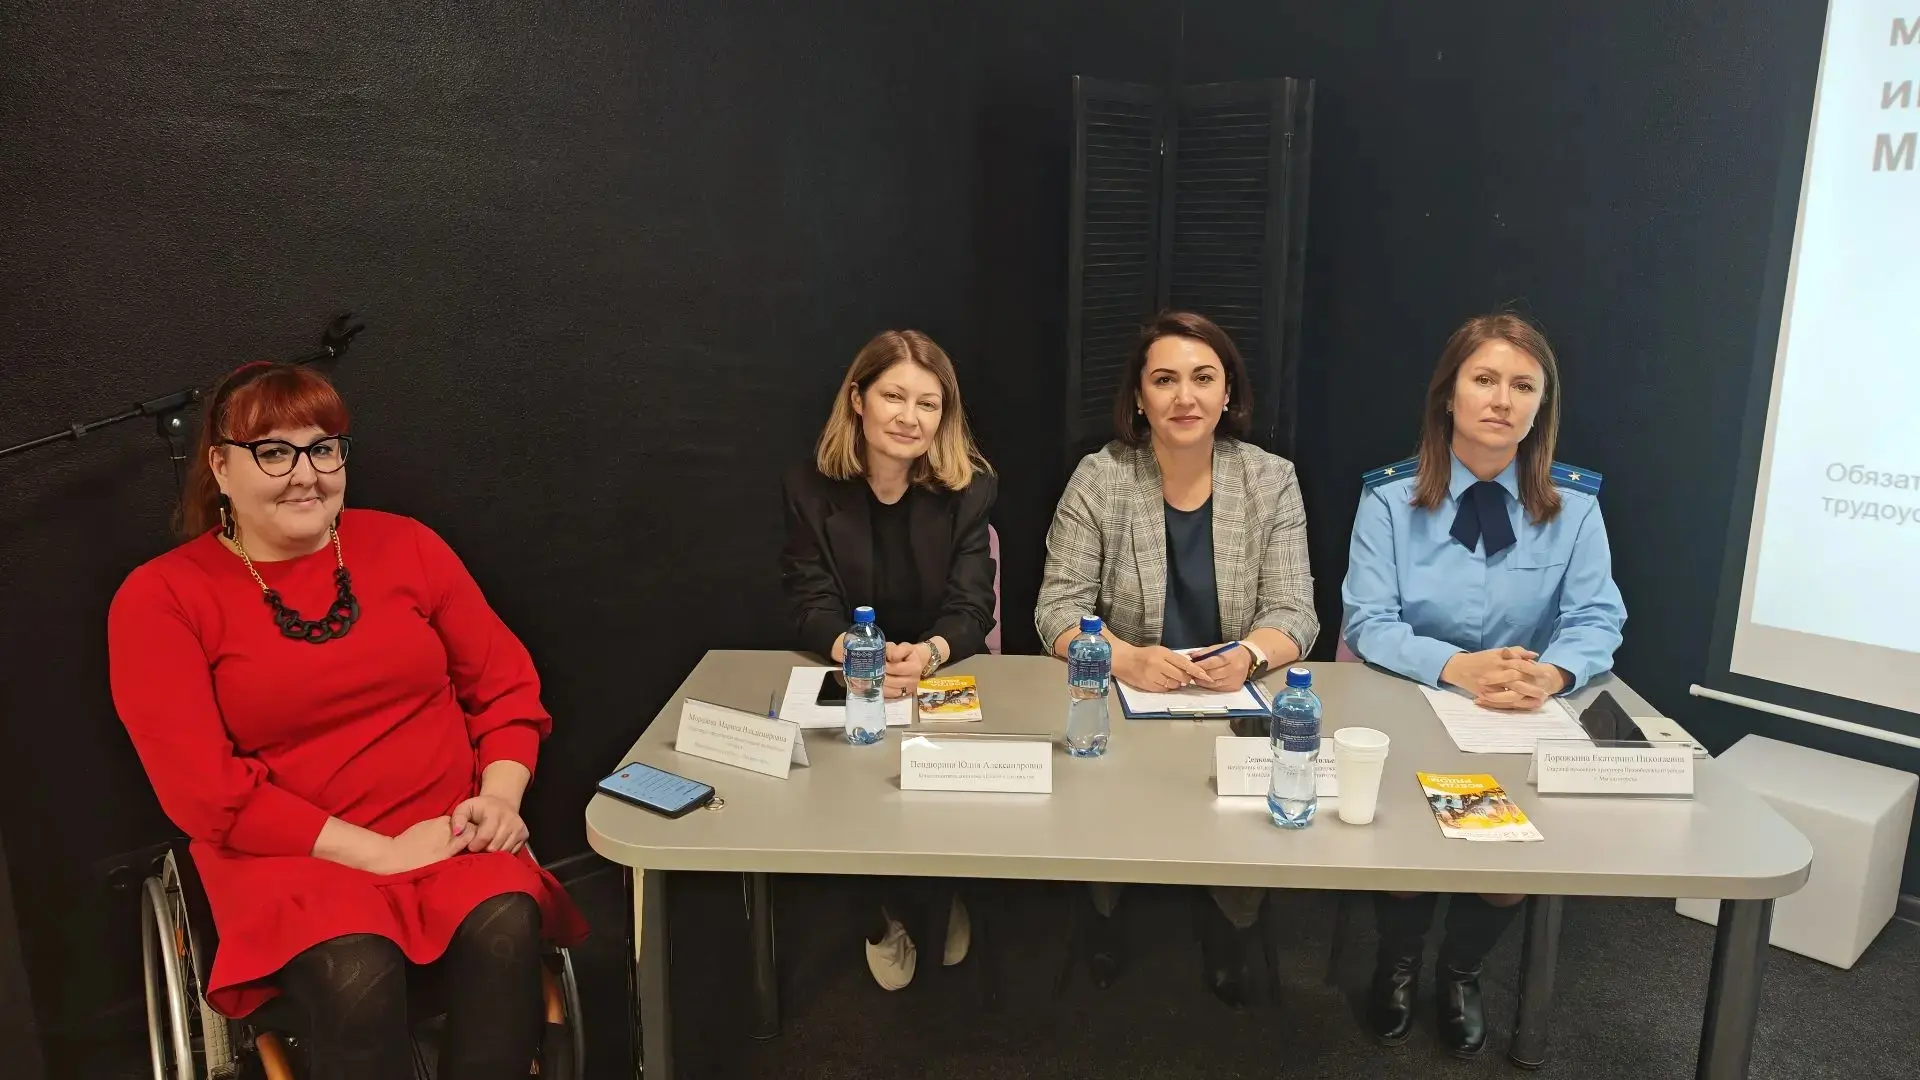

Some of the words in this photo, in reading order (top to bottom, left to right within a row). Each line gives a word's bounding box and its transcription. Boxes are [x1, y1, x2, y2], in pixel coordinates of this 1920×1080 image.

[1881, 80, 1920, 110] и
[1826, 462, 1920, 491] Обязат
[983, 761, 1043, 771] Александровна
[1592, 753, 1634, 764] Екатерина
